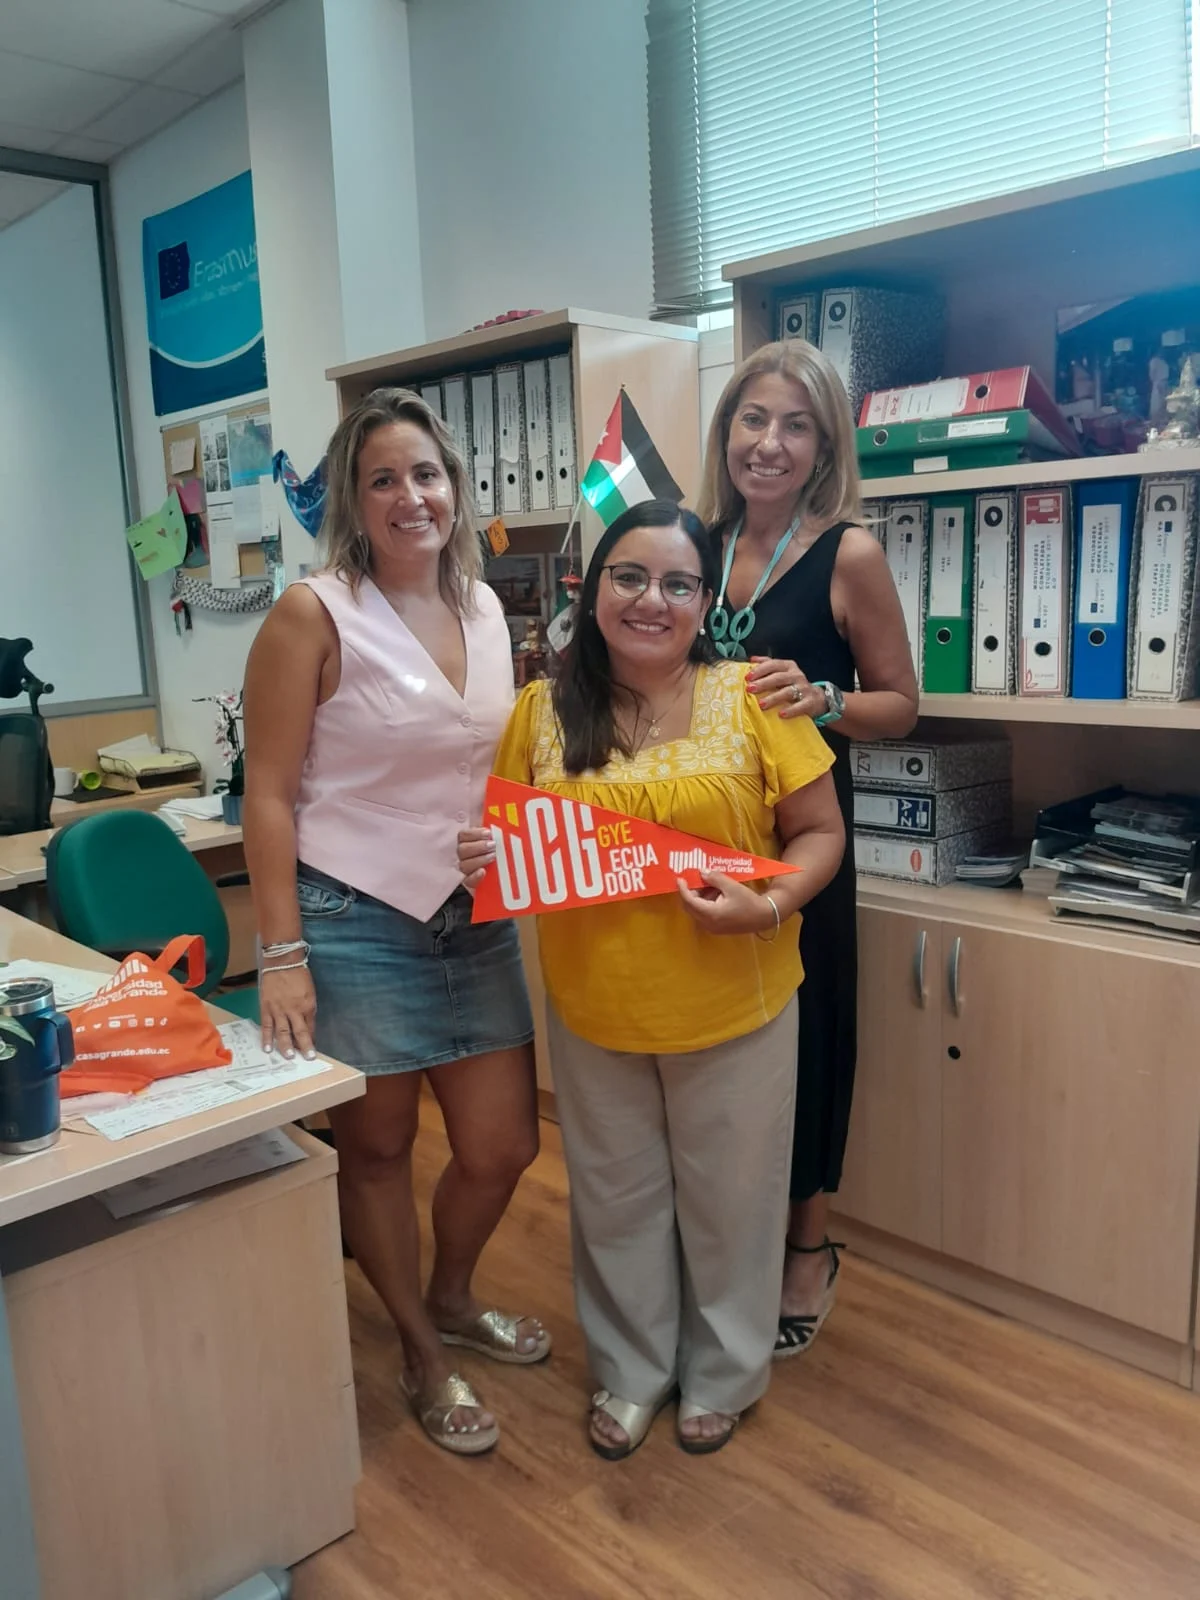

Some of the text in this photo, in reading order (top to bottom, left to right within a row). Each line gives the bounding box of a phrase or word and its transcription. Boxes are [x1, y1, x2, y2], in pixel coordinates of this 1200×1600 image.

[901, 800, 912, 827] A-Z
[597, 820, 632, 848] GYE
[610, 844, 659, 872] ECUA
[709, 855, 753, 865] Universidad
[727, 864, 755, 874] Grande
[604, 869, 646, 896] DOR
